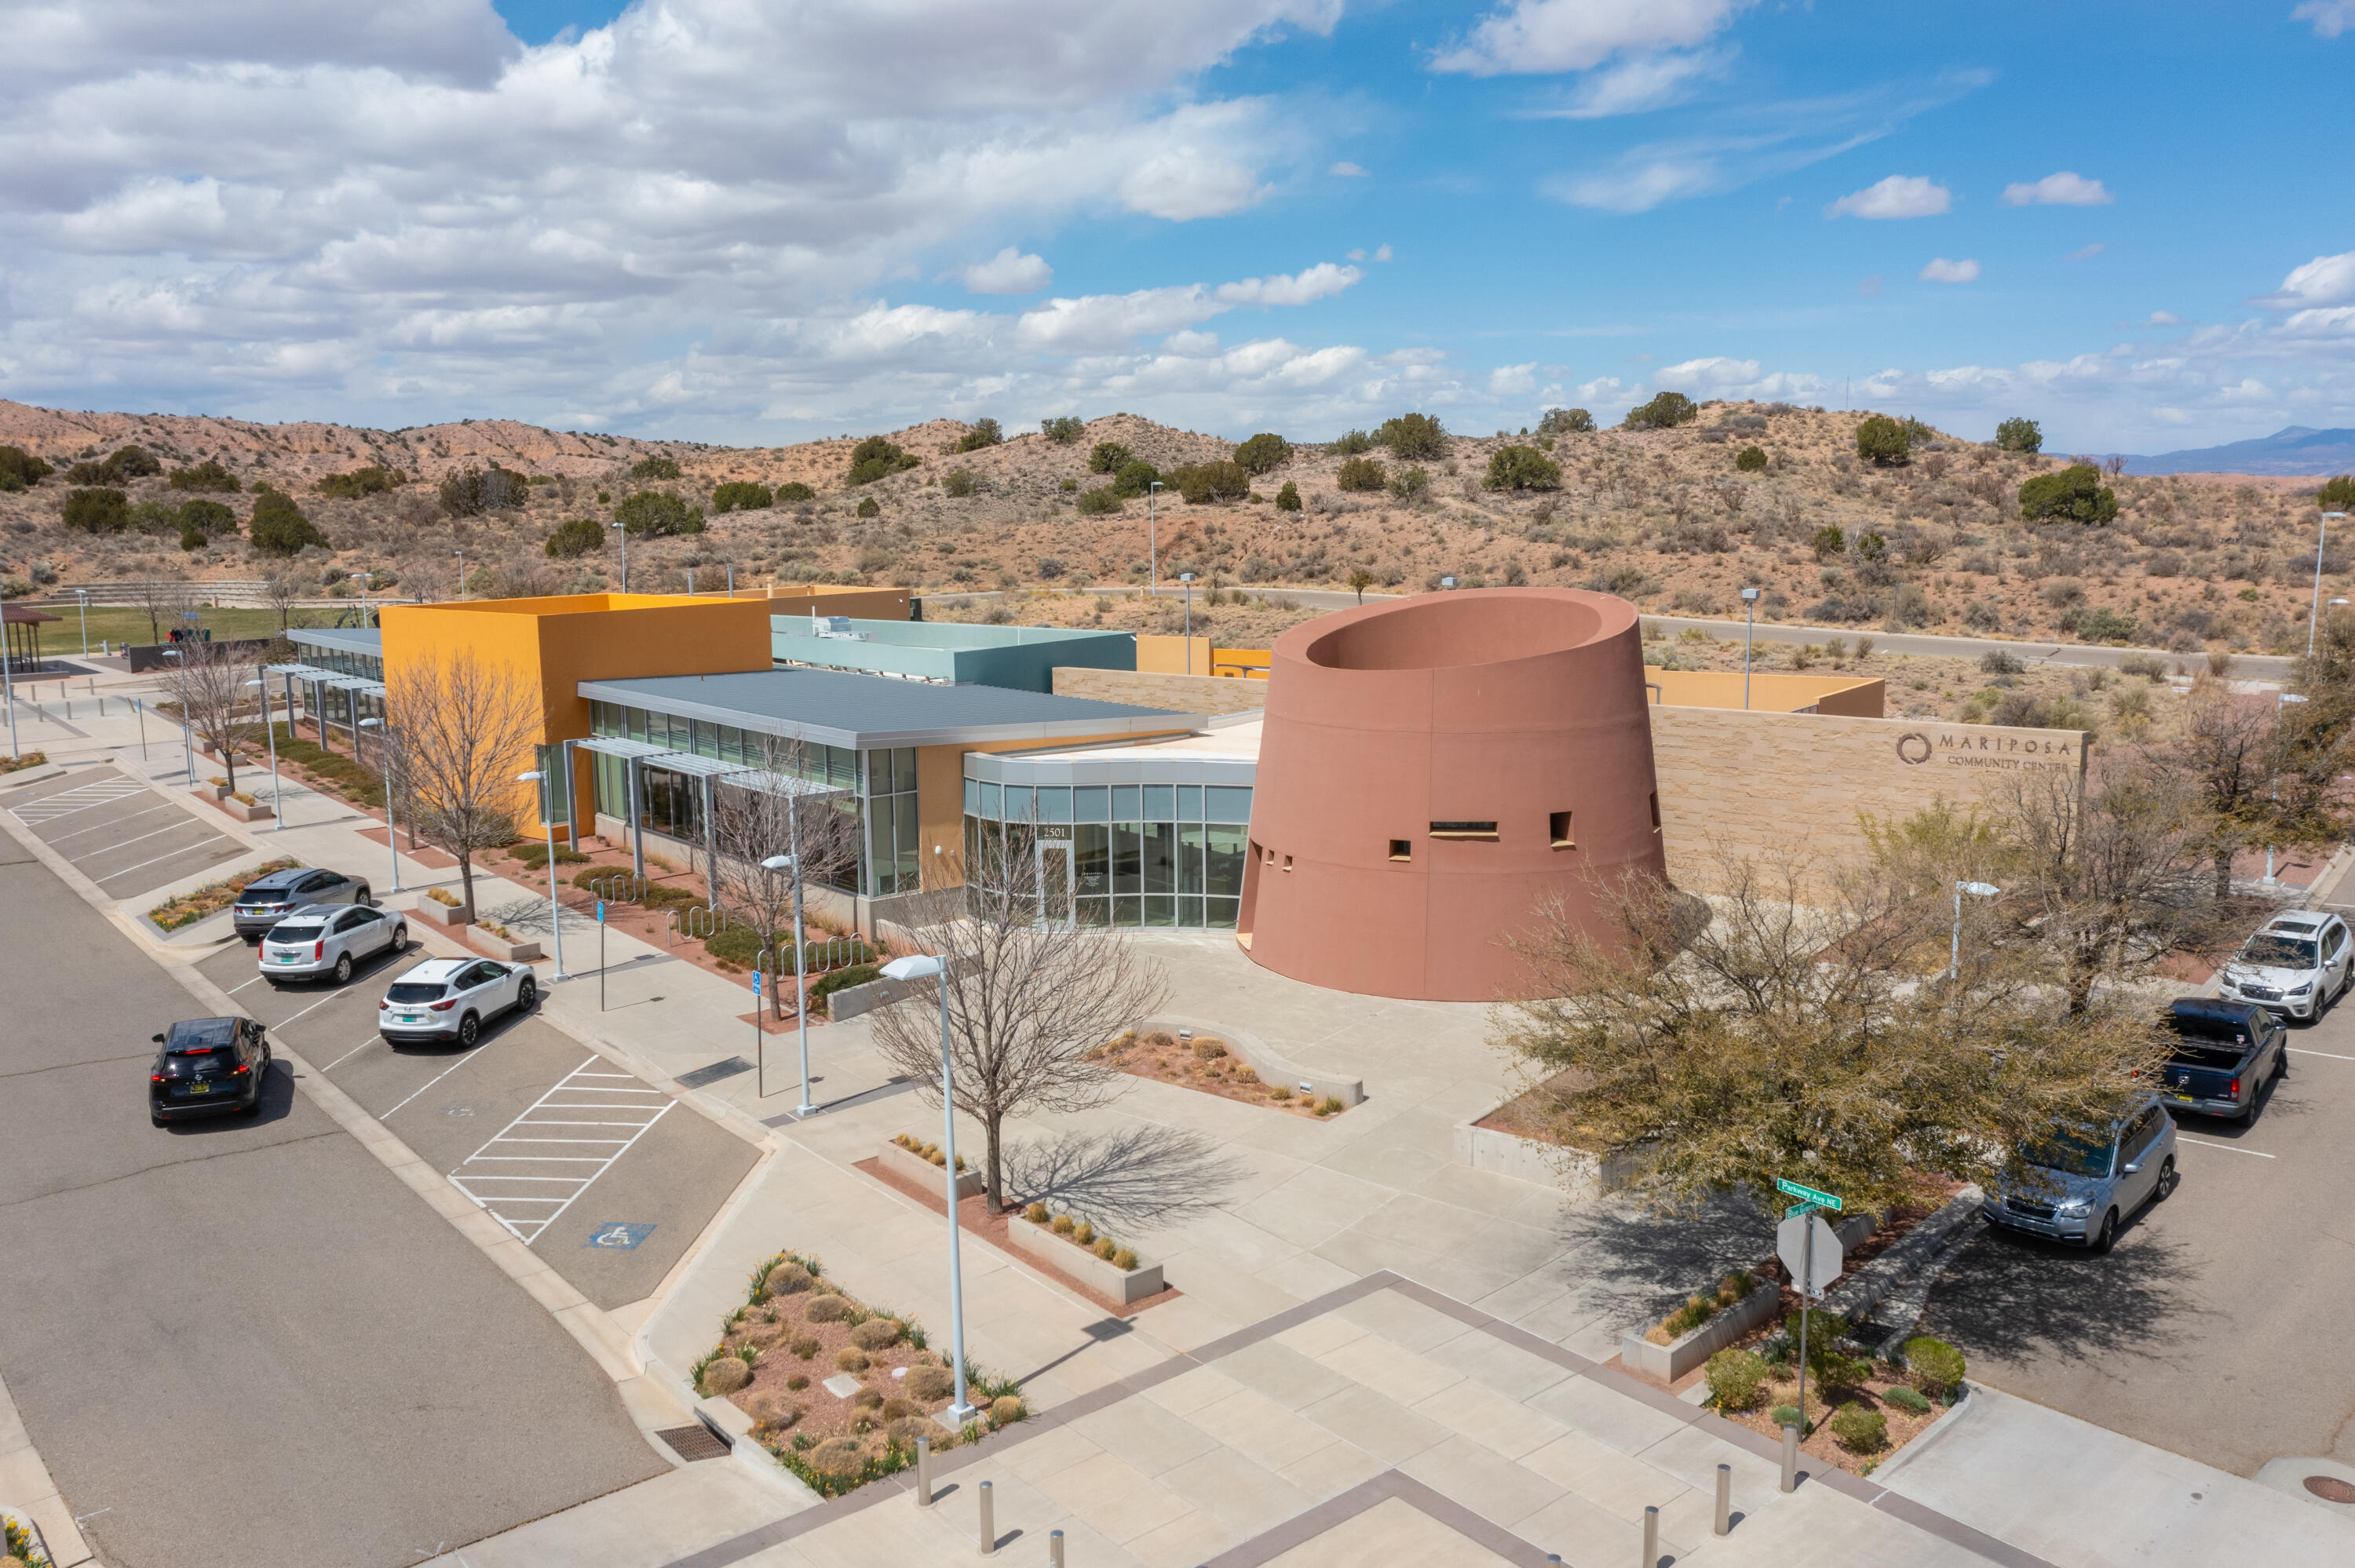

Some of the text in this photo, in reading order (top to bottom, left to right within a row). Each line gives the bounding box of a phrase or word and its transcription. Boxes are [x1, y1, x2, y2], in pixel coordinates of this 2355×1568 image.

[1940, 735, 2070, 755] MARIPOSA
[1948, 756, 2068, 772] COMMUNITY CENTER
[1044, 828, 1065, 837] 2501
[1782, 1181, 1810, 1199] Parkway
[1813, 1194, 1824, 1203] Ave
[1827, 1198, 1836, 1207] NE
[1787, 1209, 1798, 1219] Blue
